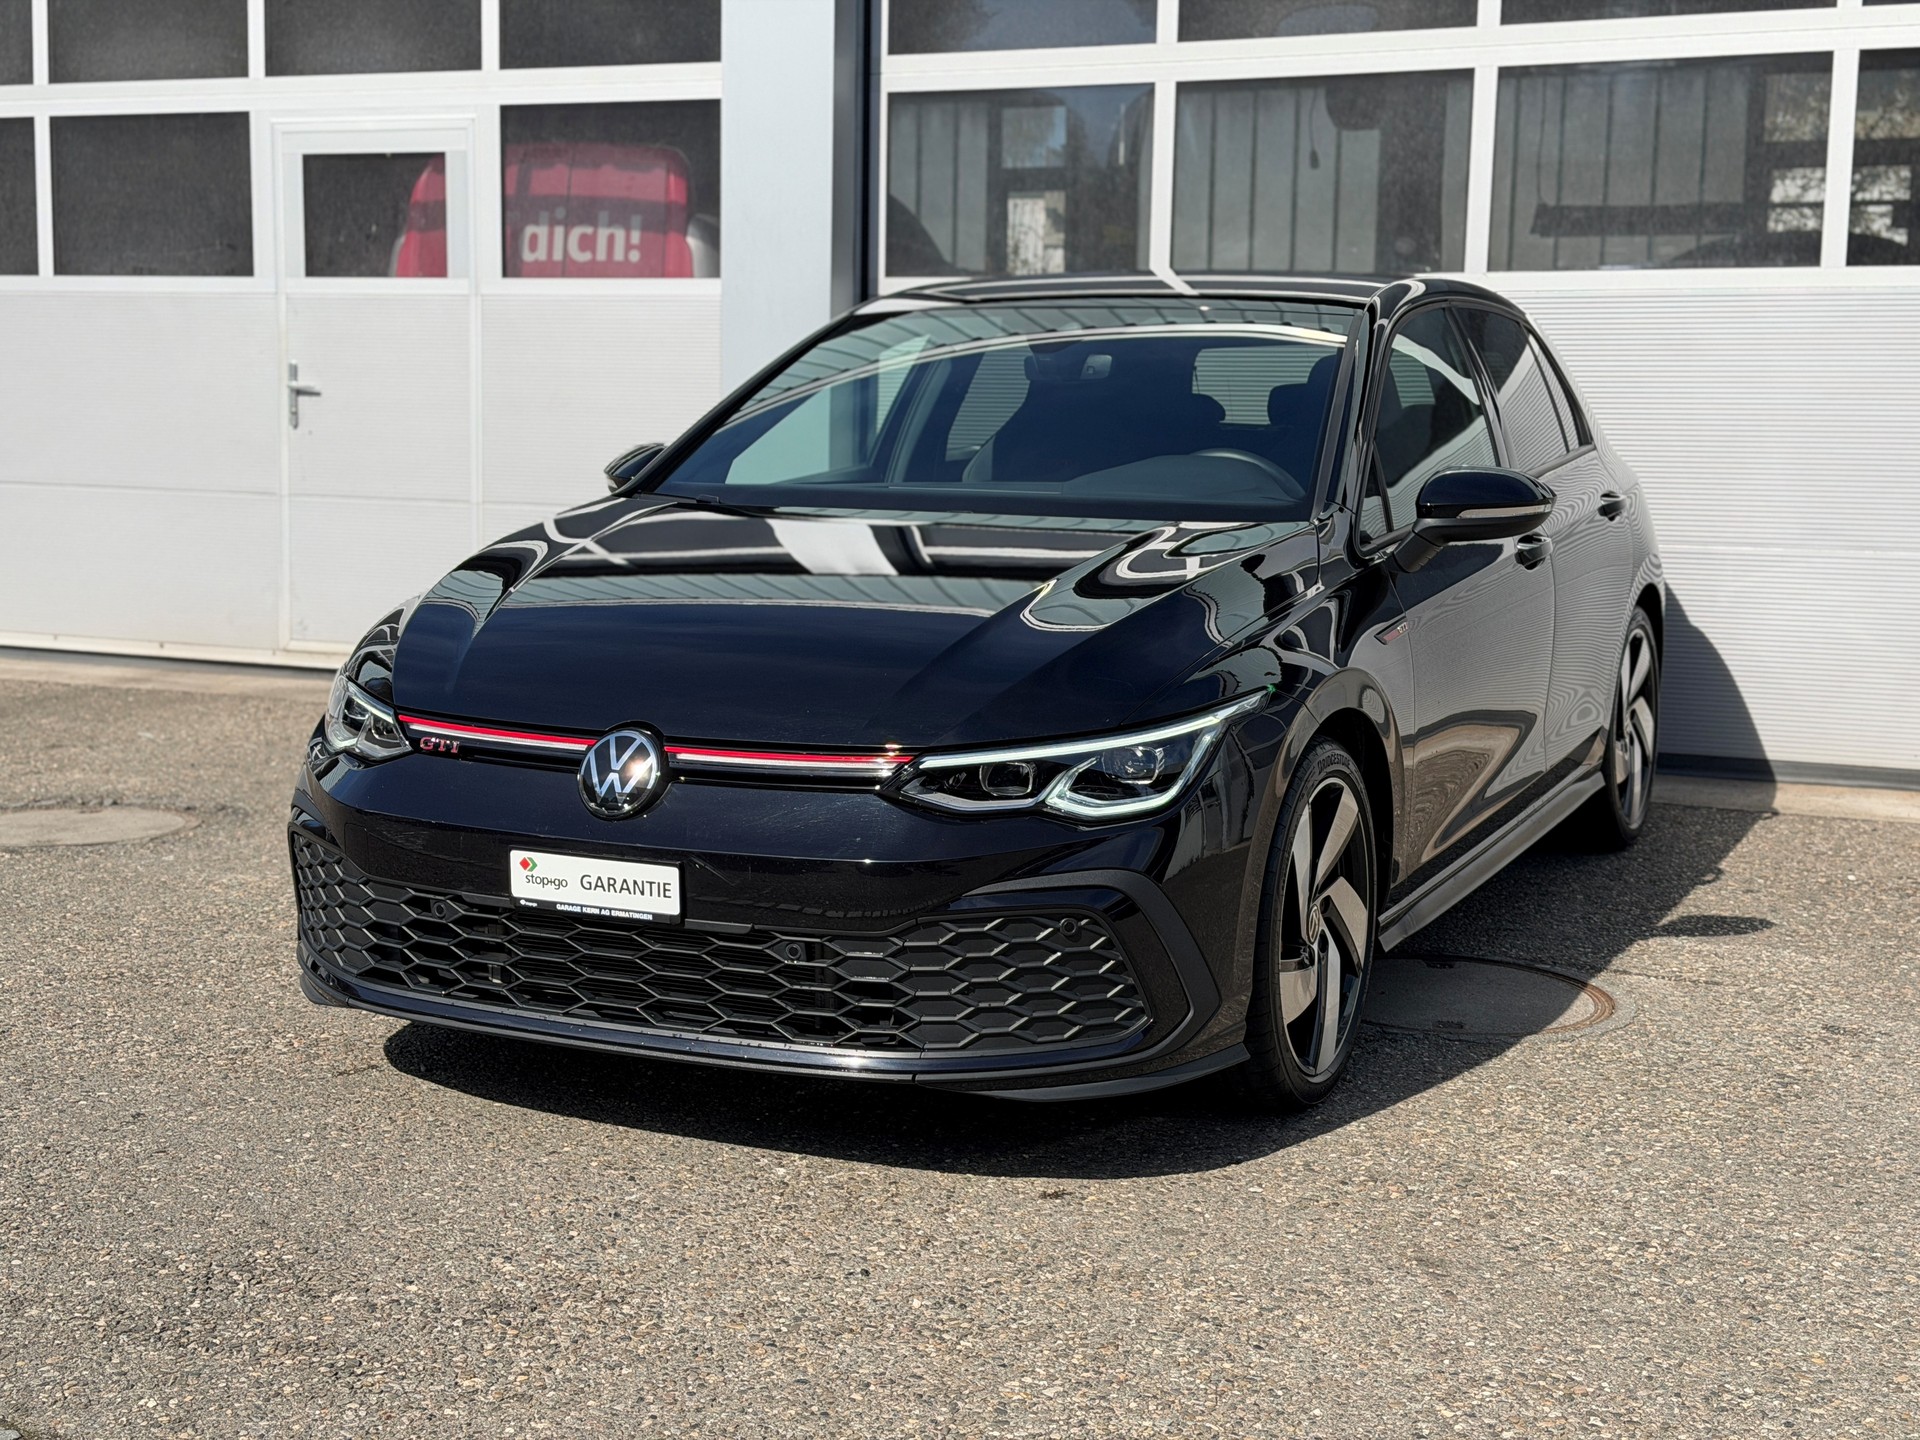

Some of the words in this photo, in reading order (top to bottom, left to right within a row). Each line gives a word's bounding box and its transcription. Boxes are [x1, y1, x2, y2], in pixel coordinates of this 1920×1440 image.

[520, 207, 643, 263] dich!
[419, 736, 460, 754] GTI
[525, 873, 568, 890] stop+go
[580, 874, 672, 899] GARANTIE
[556, 903, 582, 912] GARAGE
[582, 906, 600, 914] KERN
[600, 908, 610, 916] AG
[611, 909, 653, 920] ERMATINGEN
